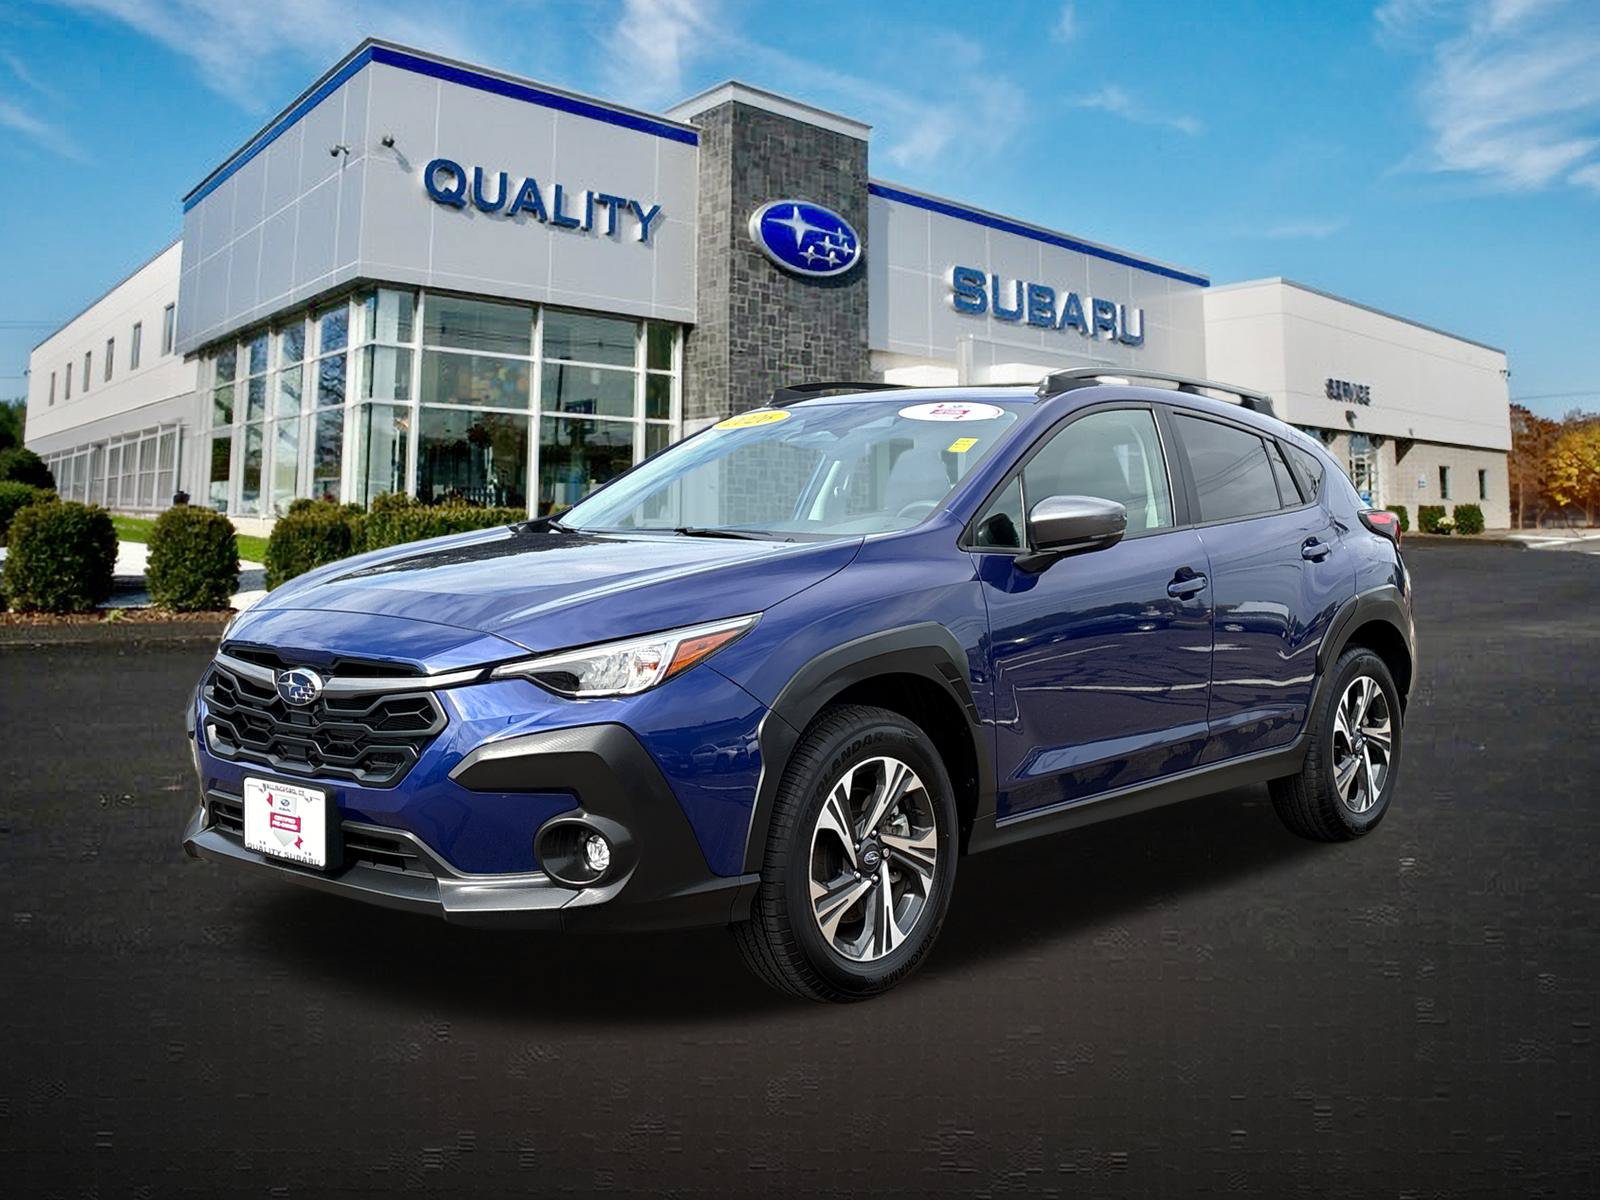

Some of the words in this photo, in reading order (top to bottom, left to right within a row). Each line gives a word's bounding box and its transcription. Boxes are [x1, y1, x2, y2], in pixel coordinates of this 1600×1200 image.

[424, 158, 661, 242] QUALITY
[952, 265, 1144, 346] SUBARU
[1325, 378, 1371, 406] SERVICE
[246, 842, 281, 856] QUALITY
